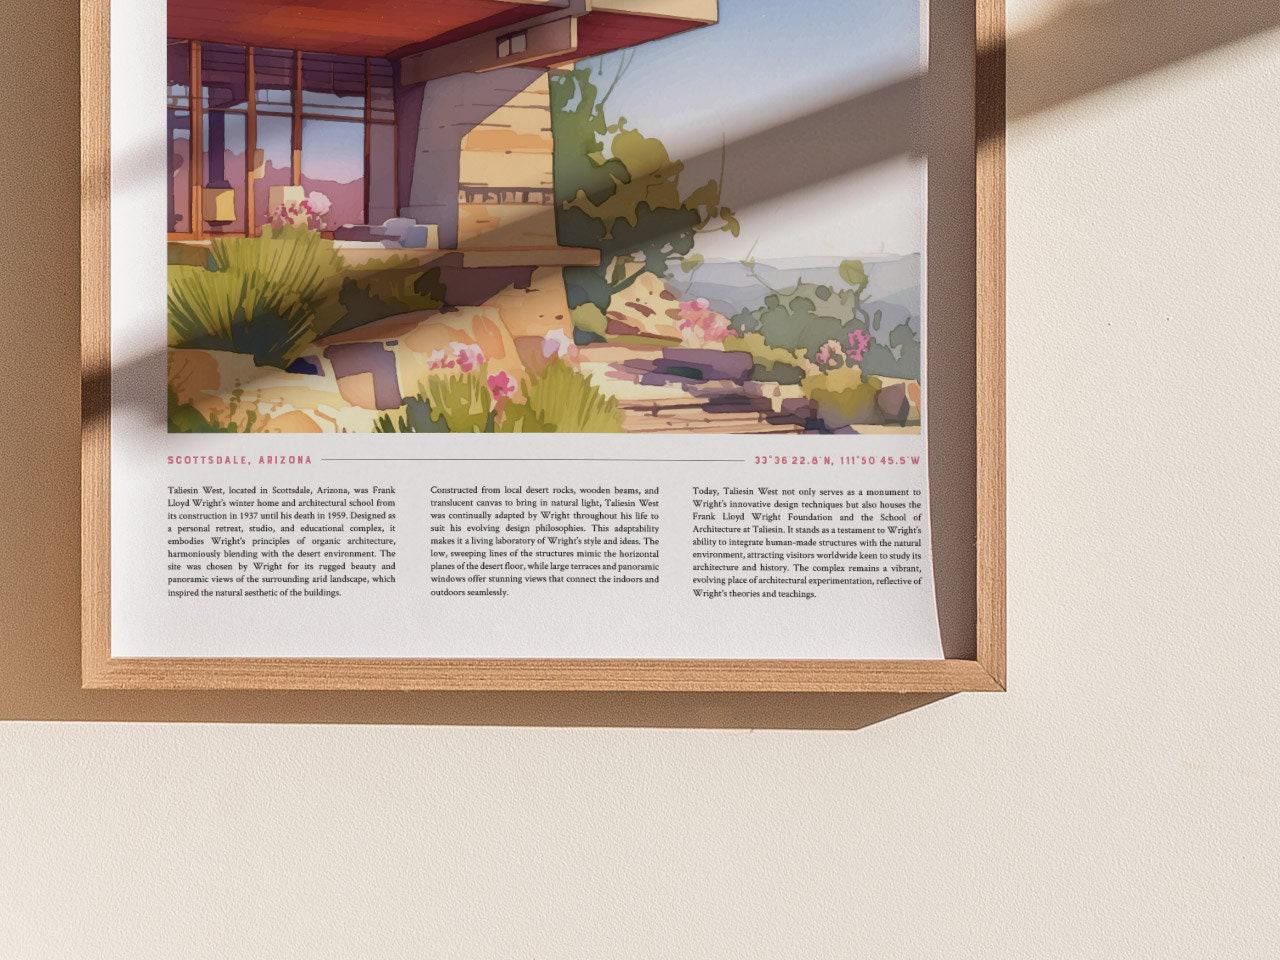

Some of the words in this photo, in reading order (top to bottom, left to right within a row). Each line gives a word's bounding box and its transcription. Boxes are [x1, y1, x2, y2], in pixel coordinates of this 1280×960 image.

[167, 456, 250, 465] SCOTTSDALE,
[259, 456, 311, 464] ARIZONA
[167, 486, 199, 494] Taliesin
[202, 486, 226, 495] West,
[228, 486, 257, 494] located
[272, 486, 313, 495] Scottsdale,
[316, 487, 350, 495] Arizona,
[372, 486, 396, 494] Frank
[430, 486, 478, 494] Constructed
[481, 486, 501, 494] from
[504, 486, 522, 494] local
[525, 486, 550, 494] desert
[552, 485, 576, 495] rocks,
[579, 486, 611, 494] wooden
[614, 486, 642, 495] beams,
[644, 487, 659, 495] and
[167, 499, 190, 509] Lloyd
[192, 499, 227, 509] Wright's
[256, 499, 280, 507] home
[281, 499, 296, 507] and
[298, 499, 347, 507] architectural
[348, 499, 374, 507] school
[376, 499, 396, 507] from
[692, 499, 728, 509] Wright's
[729, 500, 771, 508] innovative
[773, 500, 799, 510] design
[801, 500, 844, 510] techniques
[845, 500, 859, 509] but
[861, 501, 878, 509] also
[879, 501, 907, 509] houses
[448, 511, 492, 521] continually
[494, 511, 525, 521] adapted
[527, 511, 538, 521] by
[540, 511, 570, 521] Wright
[573, 511, 618, 521] throughout
[620, 512, 633, 520] his
[635, 511, 648, 520] life
[692, 512, 716, 520] Frank
[722, 512, 745, 523] Lloyd
[751, 512, 781, 523] Wright
[787, 513, 833, 521] Foundation
[839, 513, 854, 521] and
[860, 513, 874, 521] the
[880, 513, 907, 521] School
[913, 513, 923, 521] of
[430, 524, 445, 532] suit
[450, 524, 462, 532] his
[466, 524, 501, 534] evolving
[505, 524, 530, 534] design
[535, 523, 586, 534] philosophies.
[591, 524, 610, 532] This
[614, 524, 659, 534] adaptability
[167, 537, 205, 545] embodies
[211, 537, 246, 547] Wright's
[252, 537, 290, 547] principles
[311, 538, 341, 547] organic
[347, 537, 396, 545] architecture,
[692, 537, 717, 547] ability
[728, 539, 764, 548] integrate
[765, 538, 817, 546] human-made
[859, 538, 878, 546] with
[879, 539, 892, 547] the
[893, 538, 922, 547] natural
[430, 549, 448, 558] low,
[450, 550, 487, 559] sweeping
[489, 549, 508, 557] lines
[509, 549, 519, 557] of
[520, 549, 533, 557] the
[619, 550, 659, 558] horizontal
[167, 563, 182, 571] site
[206, 562, 233, 570] chosen
[238, 562, 248, 572] by
[252, 562, 283, 572] Wright
[287, 562, 300, 570] for
[304, 562, 314, 570] its
[318, 562, 346, 573] rugged
[350, 562, 377, 572] beauty
[381, 562, 396, 570] and
[692, 563, 739, 571] architecture
[741, 563, 757, 571] and
[760, 563, 790, 573] history.
[792, 563, 810, 571] The
[812, 564, 845, 574] complex
[890, 564, 922, 573] vibrant,
